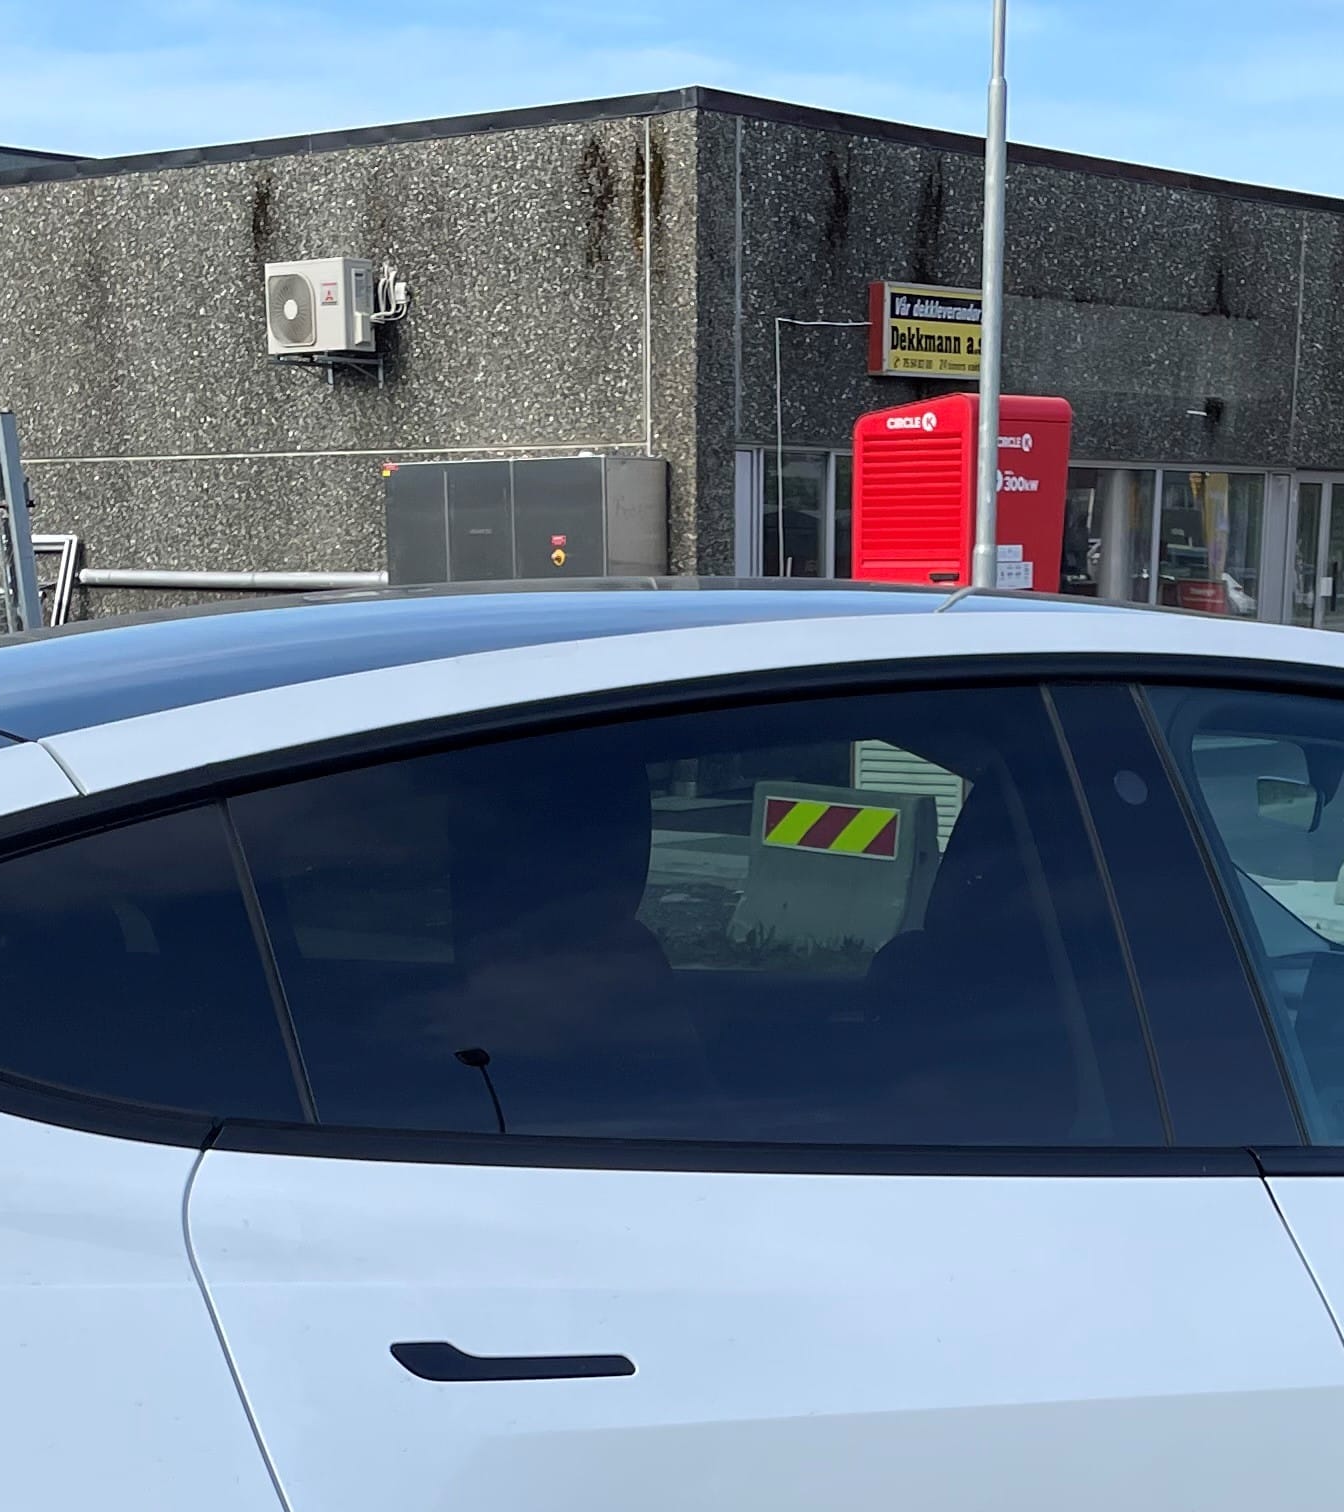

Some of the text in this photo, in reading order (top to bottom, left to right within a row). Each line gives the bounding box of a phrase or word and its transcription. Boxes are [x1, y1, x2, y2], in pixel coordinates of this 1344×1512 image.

[890, 325, 961, 354] Dekkmann
[886, 413, 937, 431] CIRCLE K
[1003, 476, 1039, 492] 300kW
